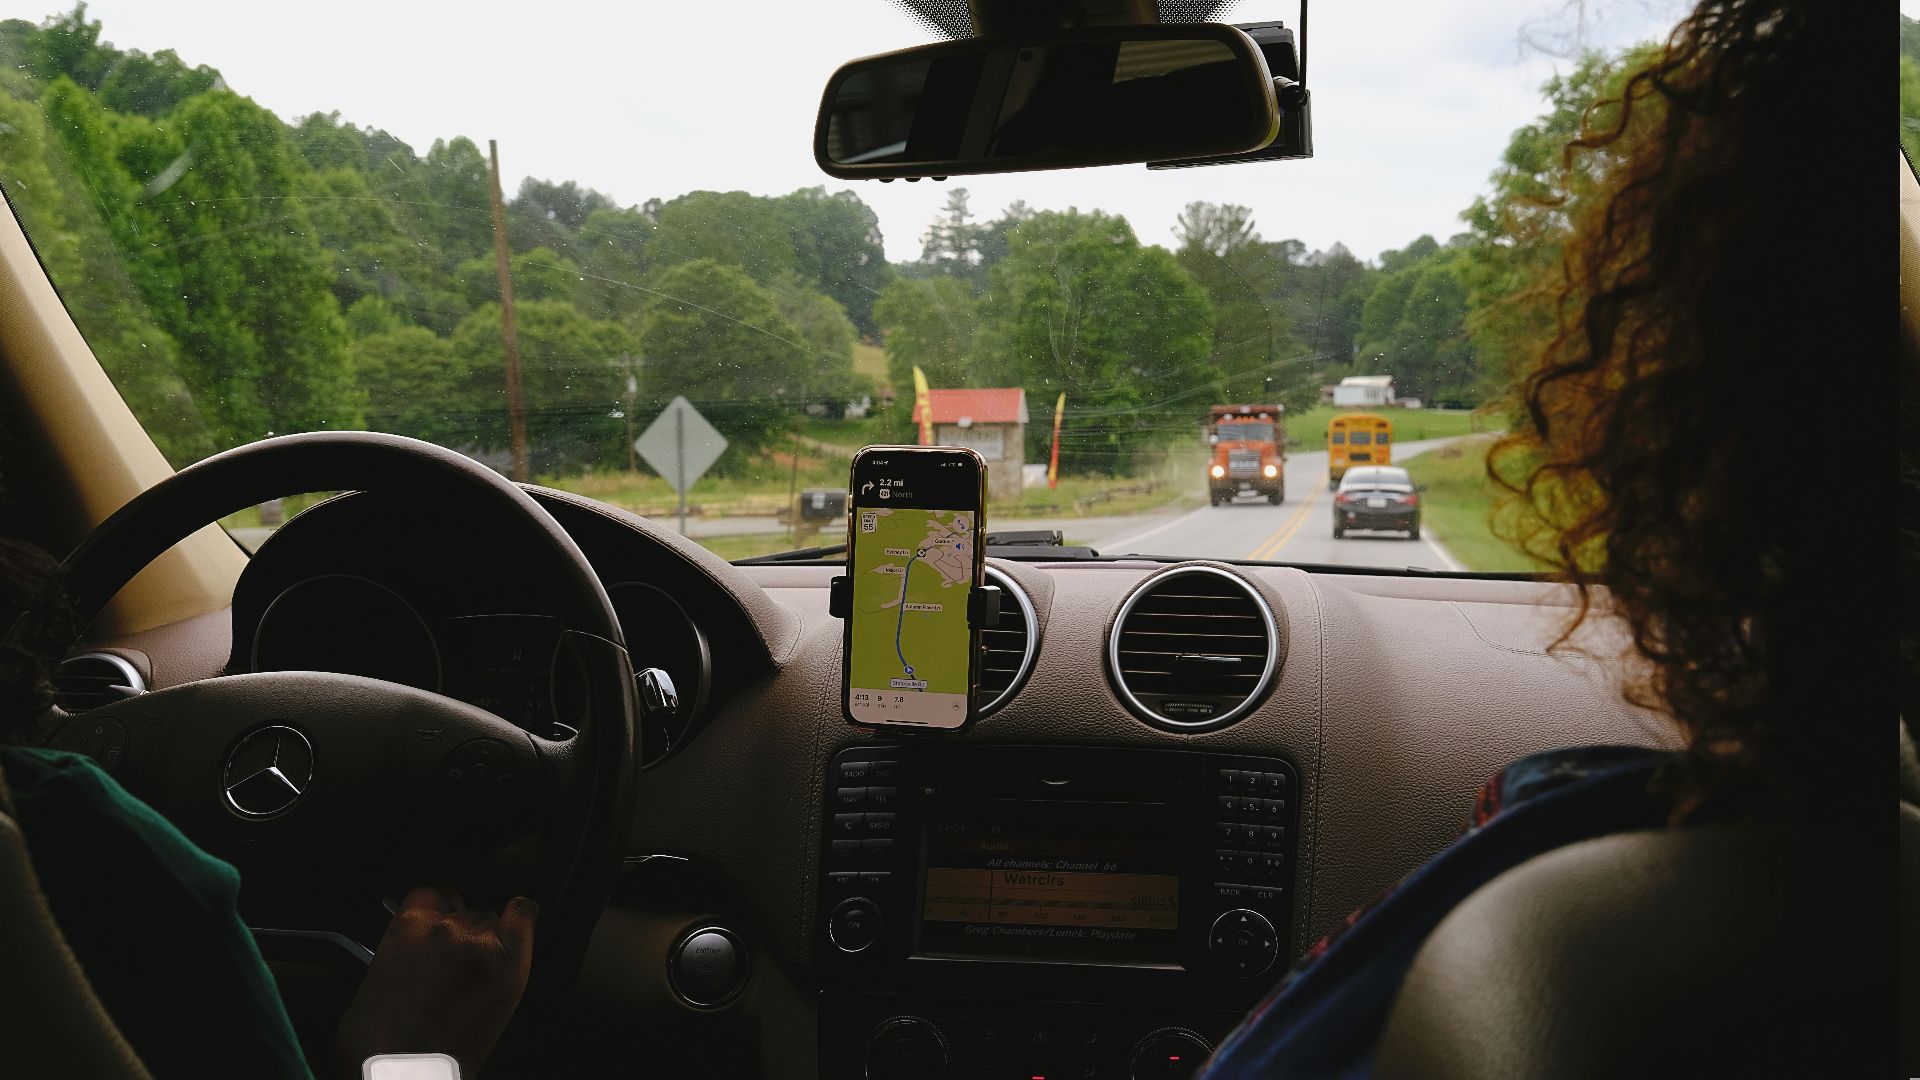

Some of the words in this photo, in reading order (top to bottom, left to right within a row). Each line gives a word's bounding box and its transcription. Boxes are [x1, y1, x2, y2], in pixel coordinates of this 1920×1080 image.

[879, 478, 892, 488] 2.2
[893, 478, 904, 488] mi
[892, 491, 913, 499] North
[863, 523, 874, 531] 55
[843, 769, 865, 778] RADIO
[1250, 777, 1256, 785] 2
[1272, 779, 1278, 787] 3
[1226, 801, 1232, 809] 4
[1249, 803, 1255, 811] 5
[1272, 805, 1277, 813] 6
[1226, 828, 1231, 836] 7
[1248, 830, 1254, 838] 8
[980, 840, 1009, 850] Audio
[988, 858, 1003, 867] All
[1004, 858, 1054, 869] channels:
[1055, 860, 1099, 870] Channel
[1103, 862, 1118, 871] 66
[1220, 888, 1241, 896] BACK
[965, 924, 990, 936] Greg
[1090, 929, 1136, 941] Playdate
[695, 947, 721, 955] ENGINE
